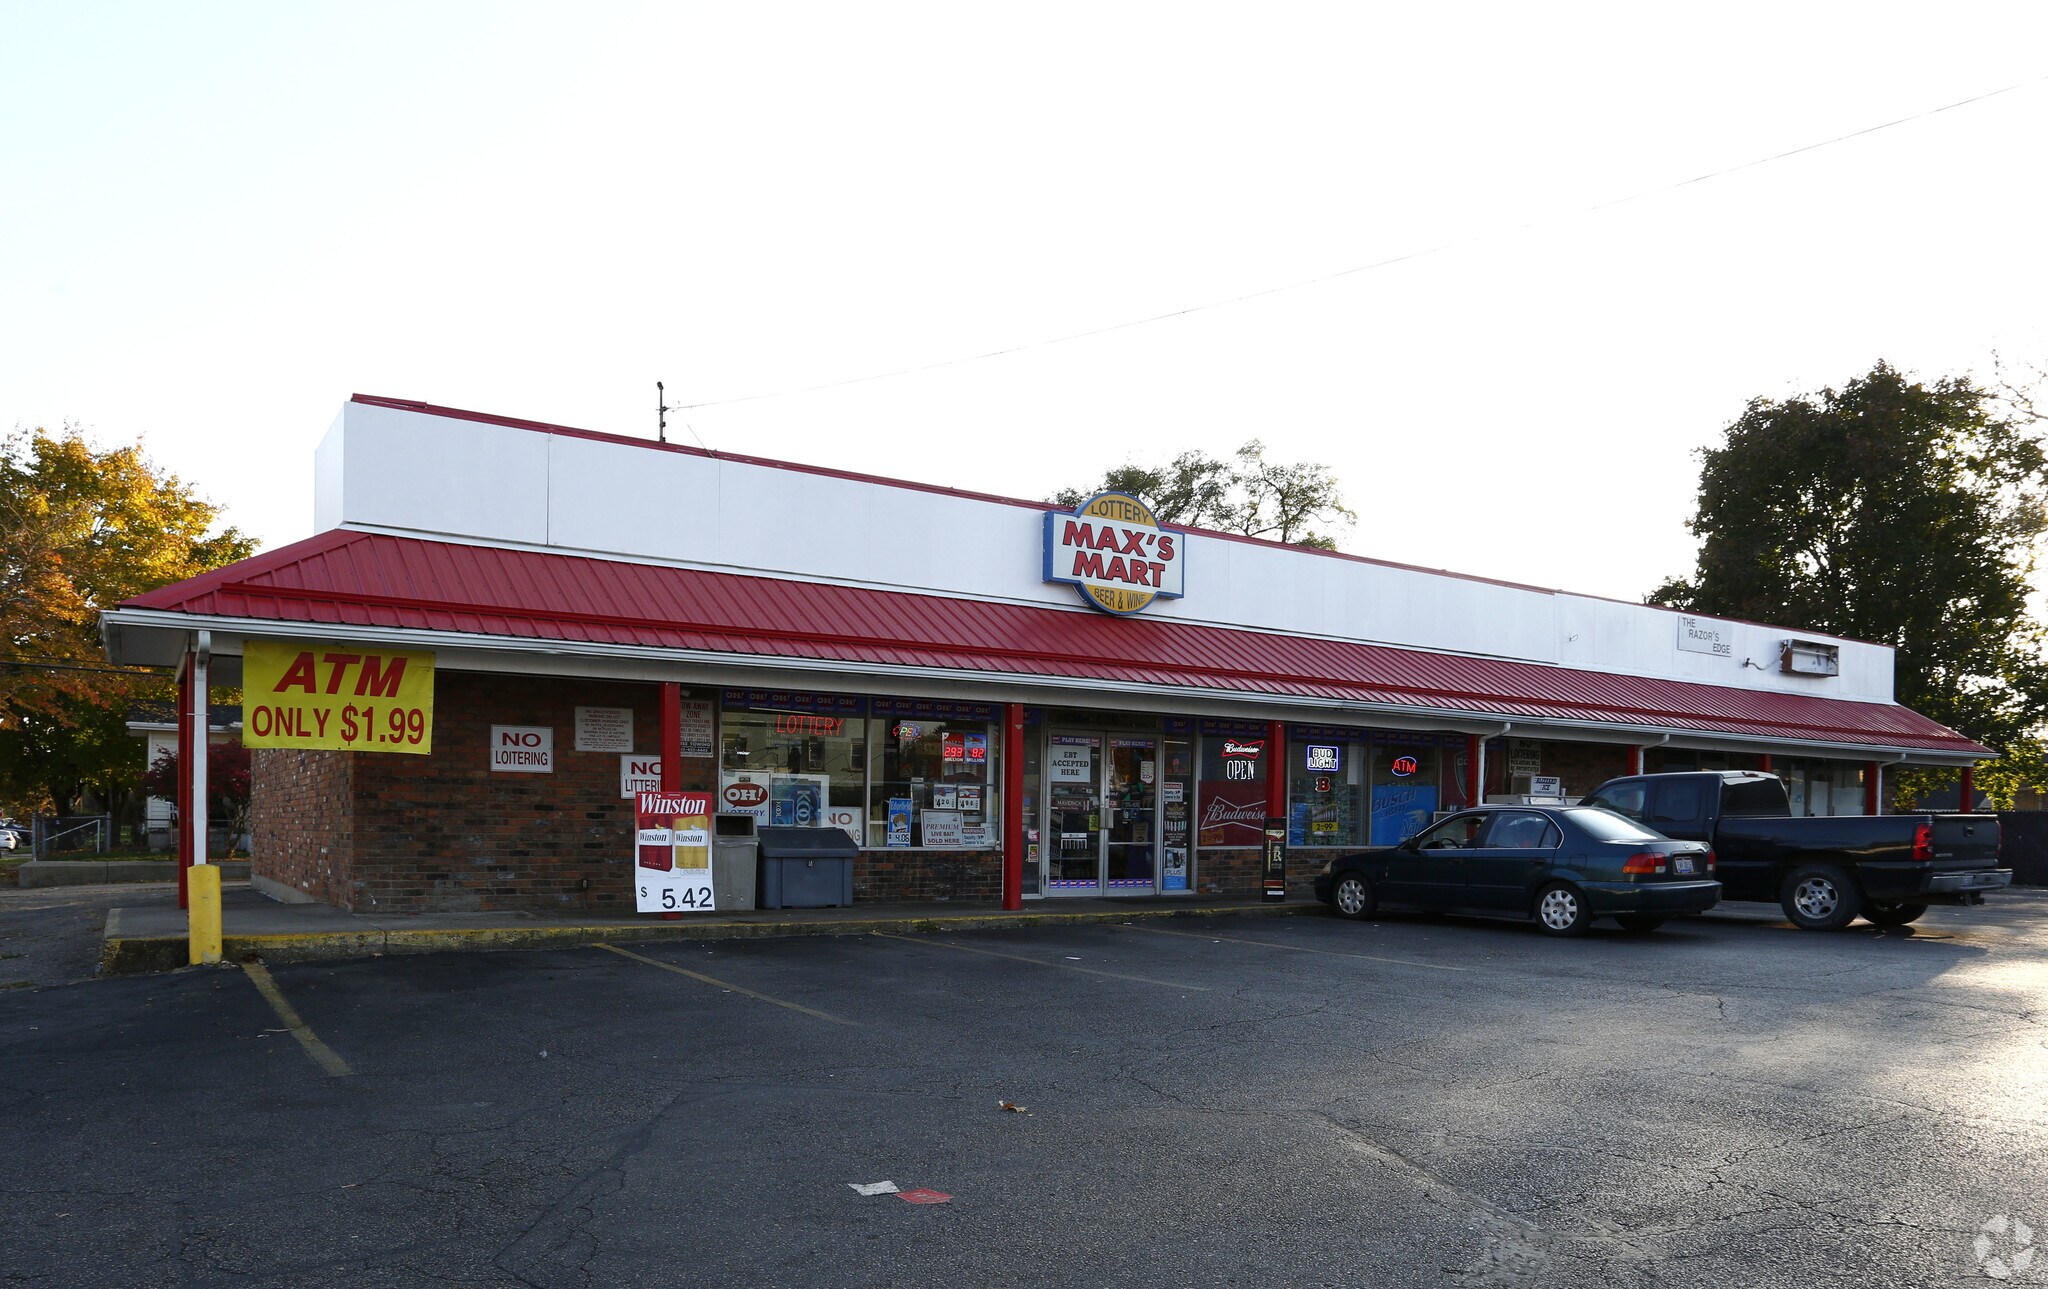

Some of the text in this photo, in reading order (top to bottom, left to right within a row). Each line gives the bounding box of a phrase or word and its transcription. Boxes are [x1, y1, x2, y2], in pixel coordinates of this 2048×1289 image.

[1091, 500, 1148, 522] LOTTERY
[1062, 520, 1174, 561] MAX'S
[1072, 550, 1165, 588] MART
[1094, 588, 1146, 610] BEER & WINE
[1682, 617, 1696, 628] THE
[1689, 630, 1720, 642] RAZOR'S
[1713, 643, 1730, 654] EDGE
[274, 652, 408, 698] ATM
[686, 710, 701, 718] ZONE
[252, 702, 424, 747] ONLY $1.99
[776, 714, 845, 736] LOTTERY
[501, 732, 542, 749] NO
[944, 747, 963, 757] 293
[972, 748, 984, 758] 82
[1224, 743, 1259, 753] Budweiser
[1312, 748, 1333, 758] BUD
[495, 749, 548, 767] LOITERING
[1309, 758, 1336, 769] LIGHT
[1226, 761, 1255, 779] OPEN
[1392, 760, 1416, 773] ATM
[726, 788, 764, 801] OH!
[640, 793, 706, 814] Winston
[796, 791, 811, 825] KOO
[1207, 804, 1266, 820] Budweise
[640, 831, 667, 842] Winston
[676, 833, 702, 843] Winston
[1273, 851, 1281, 861] R
[640, 886, 712, 909] $ 5.42
